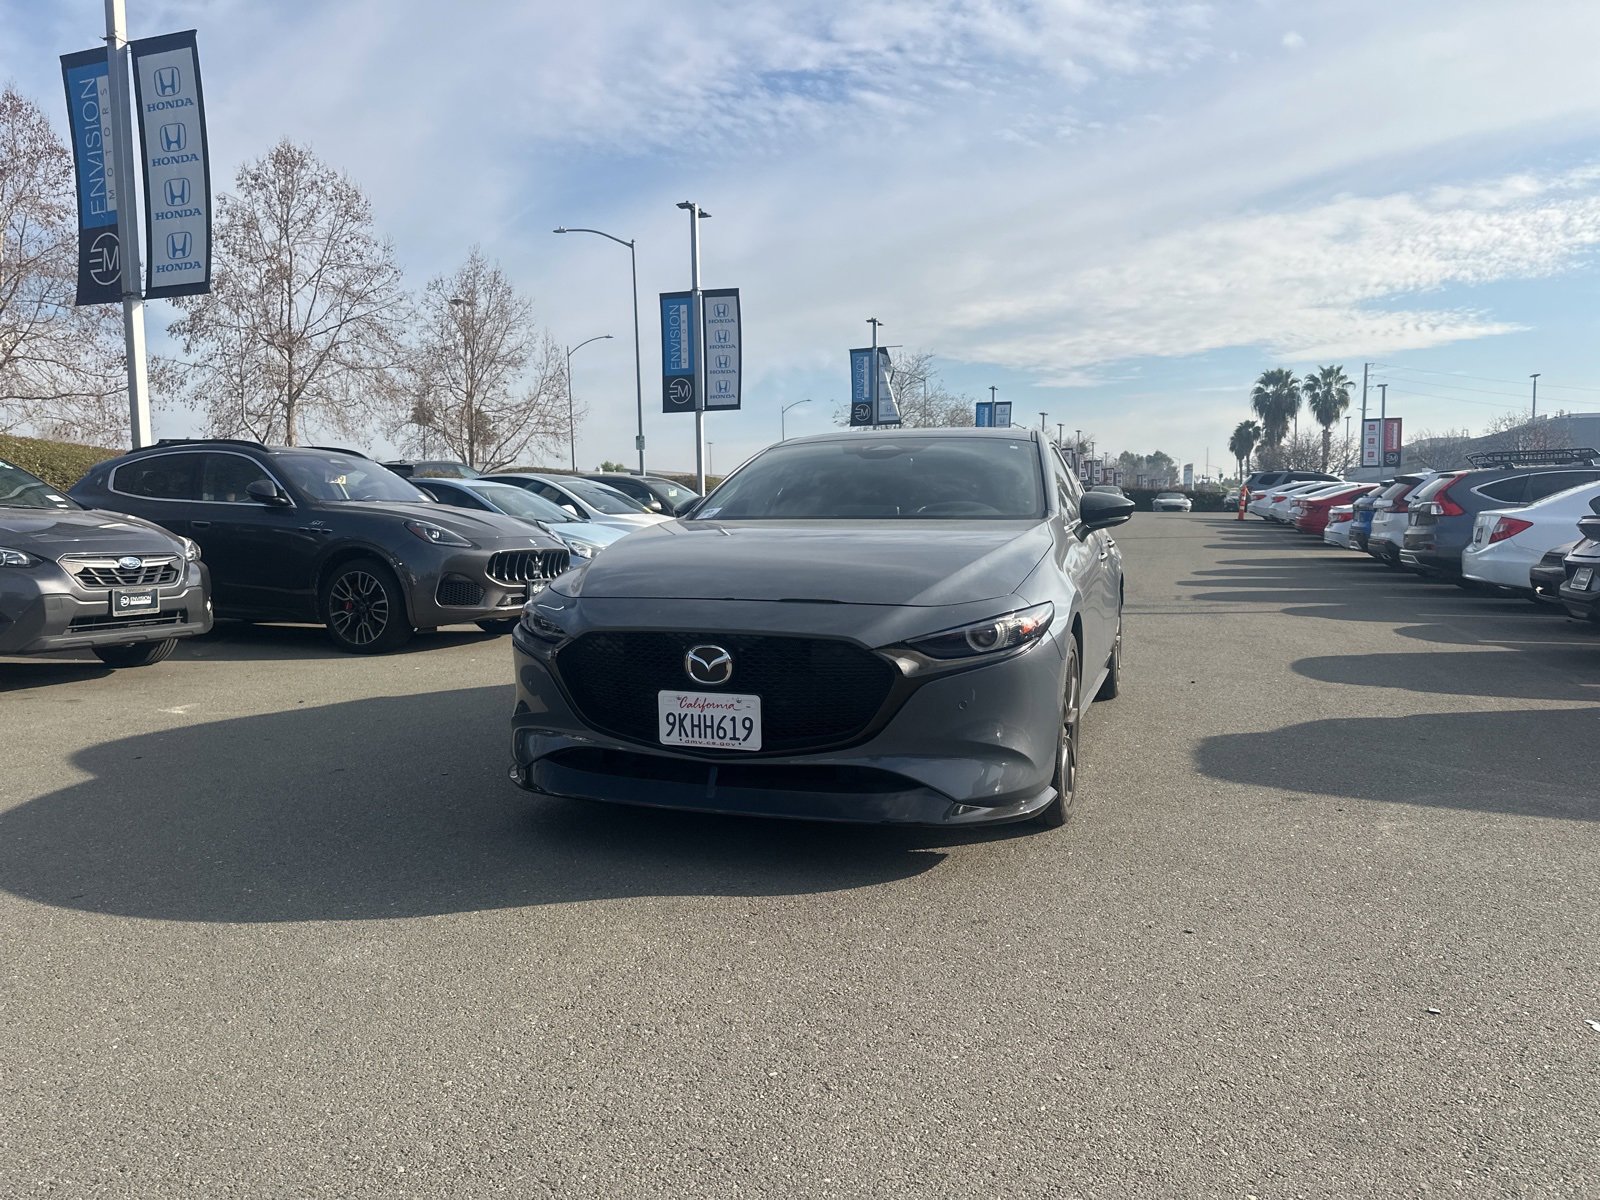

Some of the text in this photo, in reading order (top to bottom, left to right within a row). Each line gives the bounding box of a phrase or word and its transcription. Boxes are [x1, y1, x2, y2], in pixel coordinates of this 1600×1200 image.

[147, 97, 194, 112] HONDA
[79, 77, 106, 215] ENVISION
[101, 87, 115, 200] MOTORS
[152, 153, 199, 167] HONDA
[155, 207, 202, 221] HONDA
[156, 261, 202, 273] HONDA
[669, 304, 681, 370] ENVISION
[680, 696, 736, 713] California
[665, 712, 754, 742] 9KHH619
